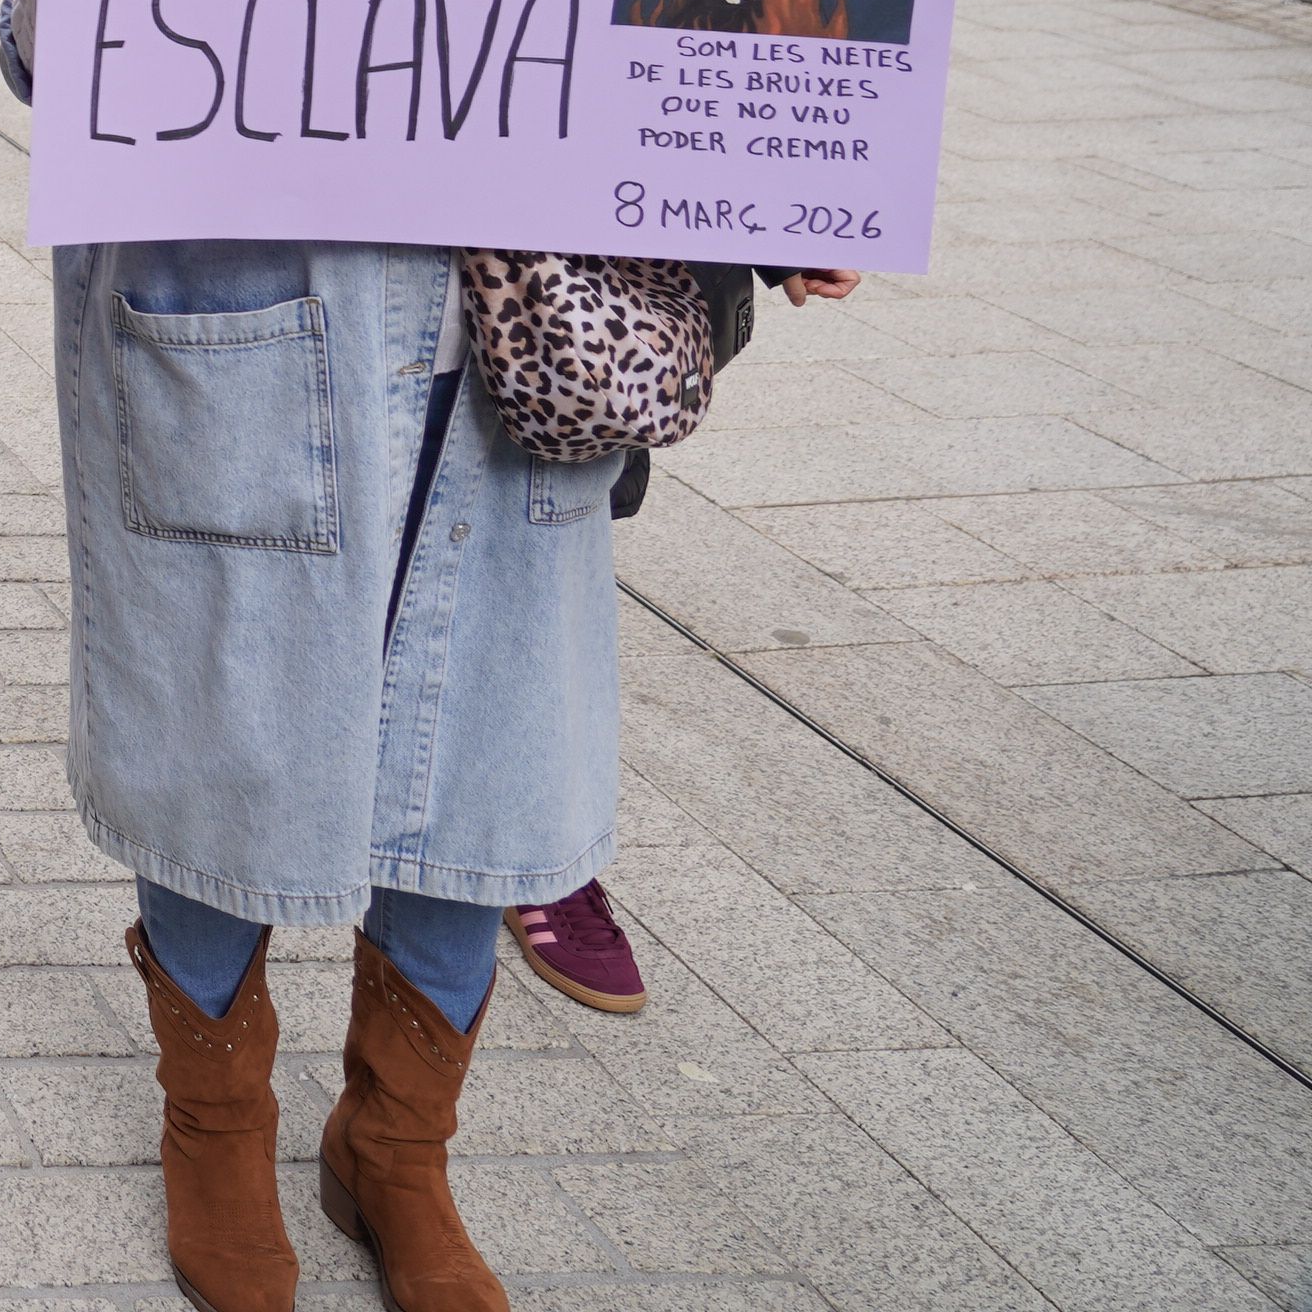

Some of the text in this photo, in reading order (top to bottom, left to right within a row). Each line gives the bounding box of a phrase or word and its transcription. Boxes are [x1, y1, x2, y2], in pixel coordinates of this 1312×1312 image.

[677, 36, 912, 72] SOM LES NETES
[627, 61, 665, 83] DE
[679, 68, 734, 89] LES
[661, 96, 850, 125] QUE NO VAU
[638, 128, 869, 161] PODER CREMAR
[614, 181, 645, 228] 8
[783, 204, 882, 239] 2026
